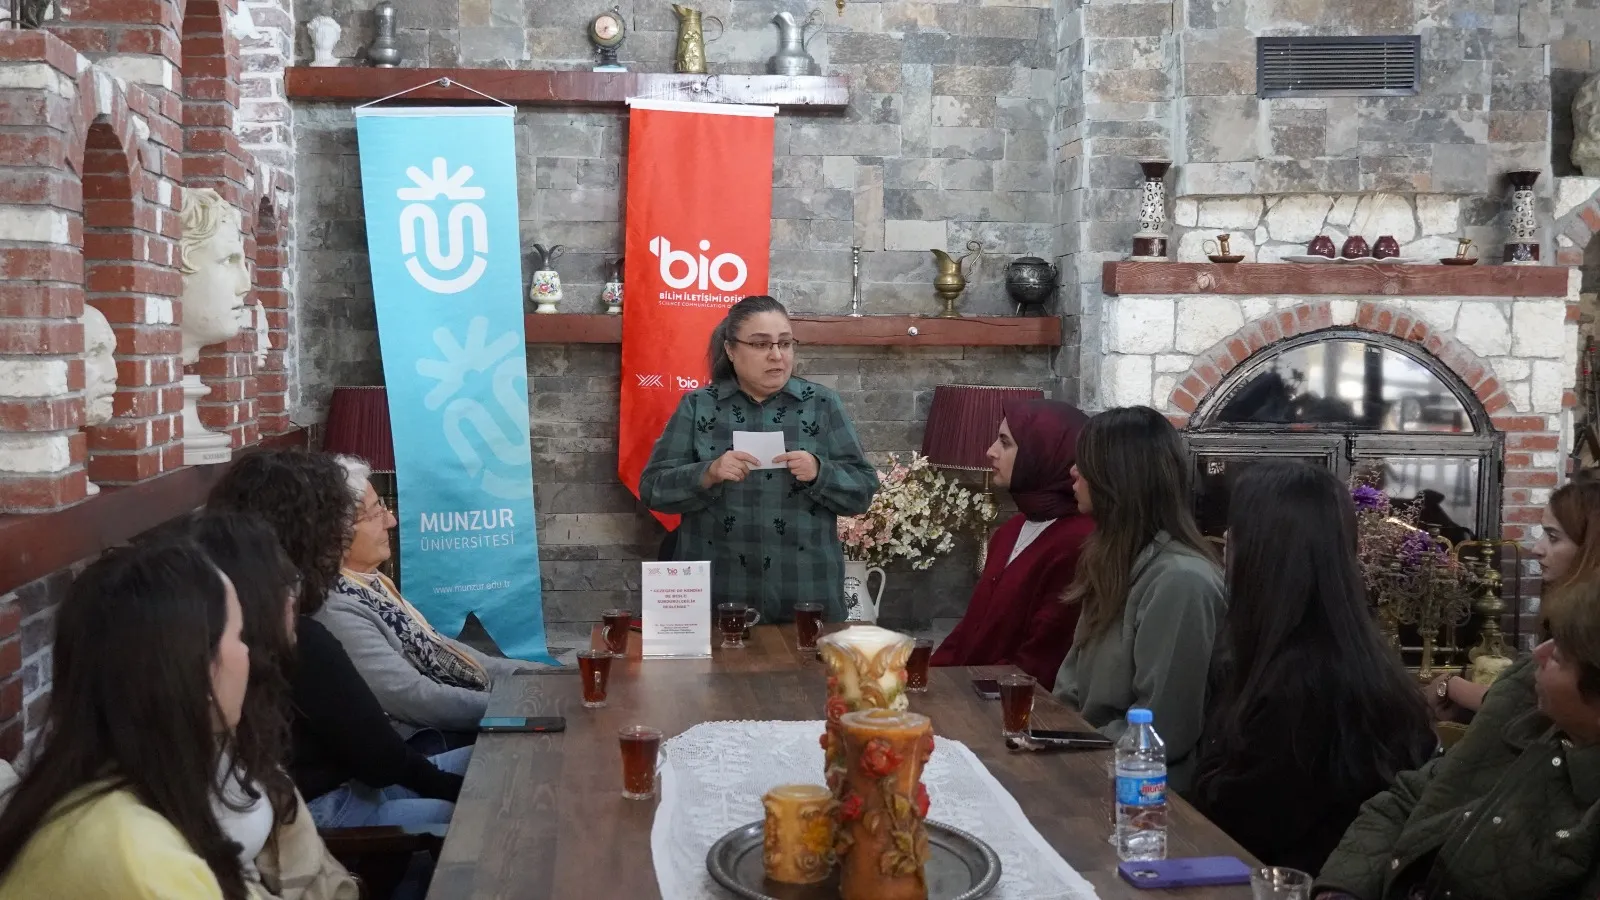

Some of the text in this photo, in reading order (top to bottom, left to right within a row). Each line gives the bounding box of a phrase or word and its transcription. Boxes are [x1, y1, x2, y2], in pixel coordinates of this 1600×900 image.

[649, 235, 748, 292] bio
[659, 290, 683, 300] BİLİM
[684, 292, 722, 303] İLETİŞİMİ
[676, 376, 699, 388] bio
[420, 508, 515, 532] MUNZUR
[421, 531, 514, 552] ÜNİVERSİTESİ
[432, 580, 512, 594] www.munzur.edu.tr
